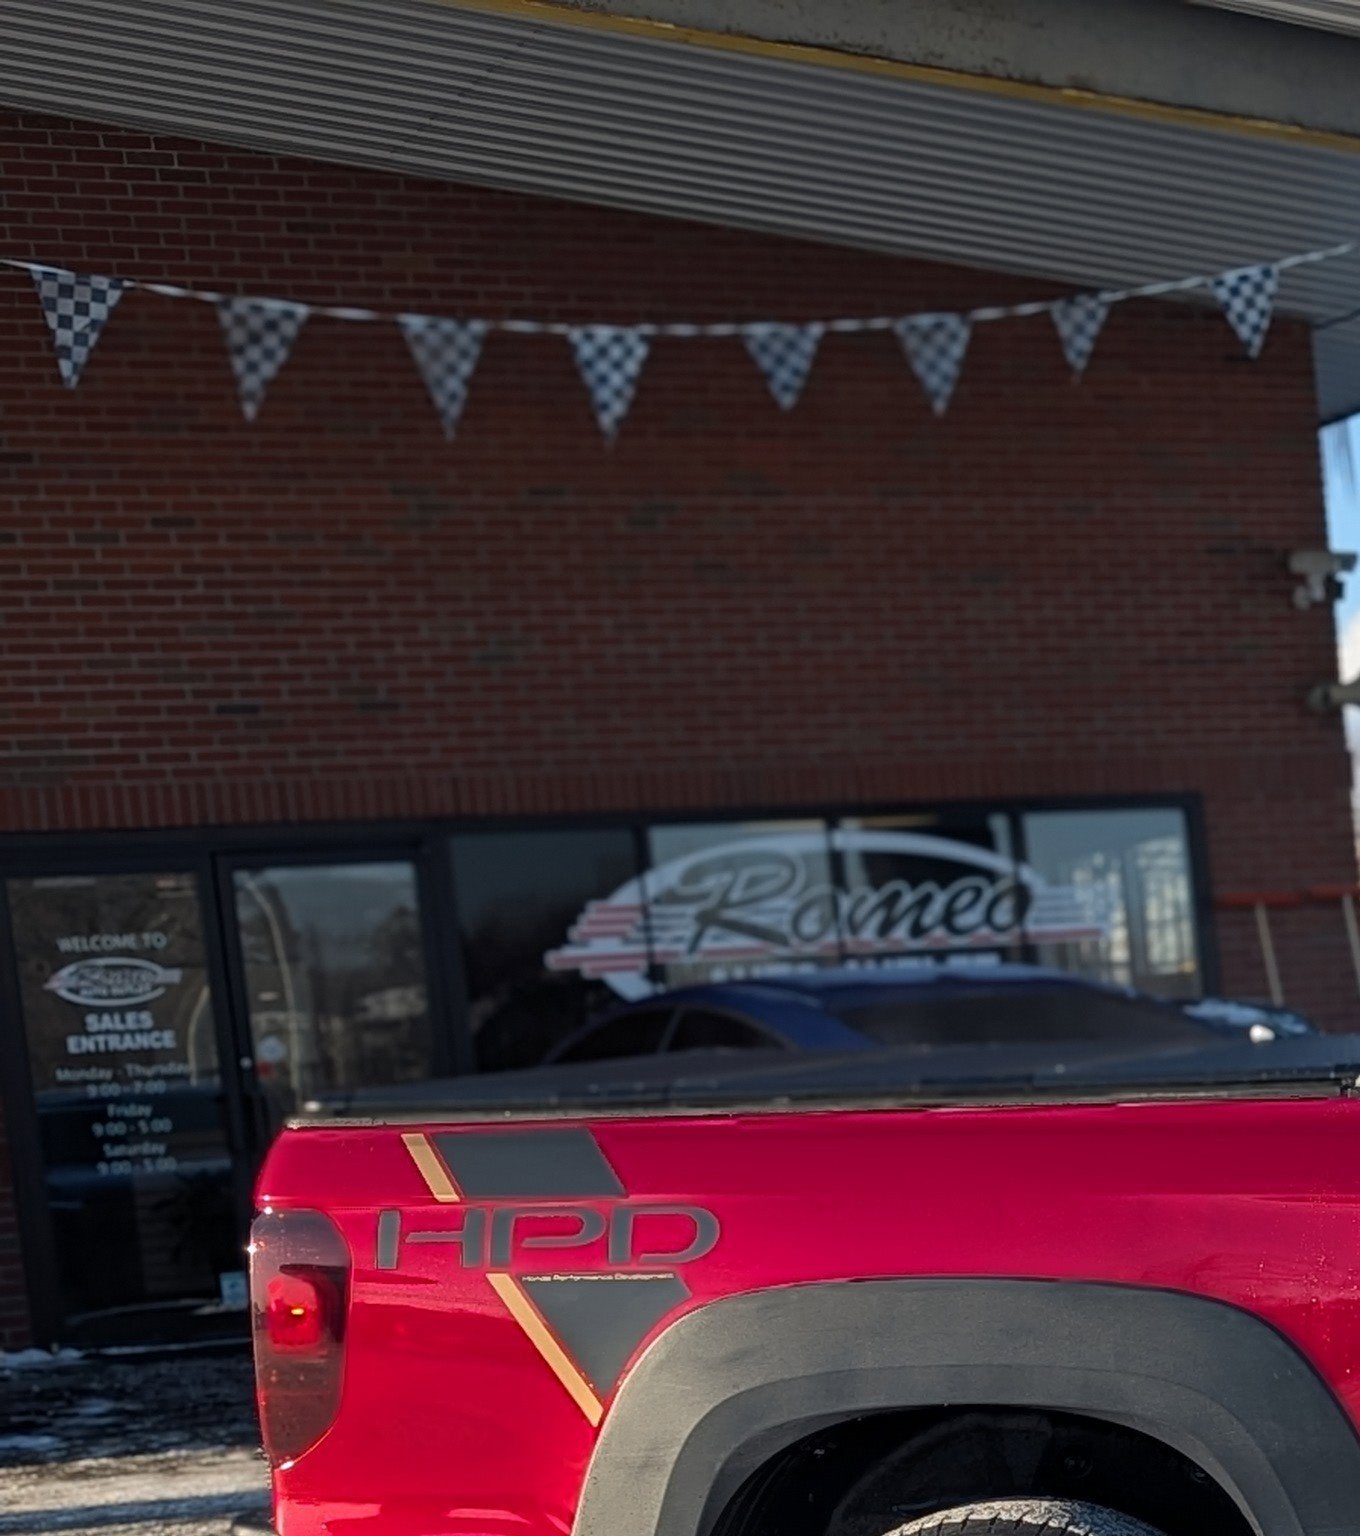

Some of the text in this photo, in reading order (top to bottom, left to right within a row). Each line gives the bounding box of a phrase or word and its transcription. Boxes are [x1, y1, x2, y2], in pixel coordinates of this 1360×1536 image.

[655, 850, 1033, 956] Romeo
[56, 931, 168, 952] WELCOME TO
[84, 1010, 154, 1032] SALES
[66, 1029, 177, 1054] ENTRANCE
[55, 1066, 113, 1082] Monday
[85, 1082, 122, 1099] 900
[106, 1103, 153, 1118] Friday
[91, 1120, 127, 1138] 900
[102, 1141, 167, 1158] Saturday
[97, 1159, 132, 1176] 900
[376, 1205, 721, 1270] HPD
